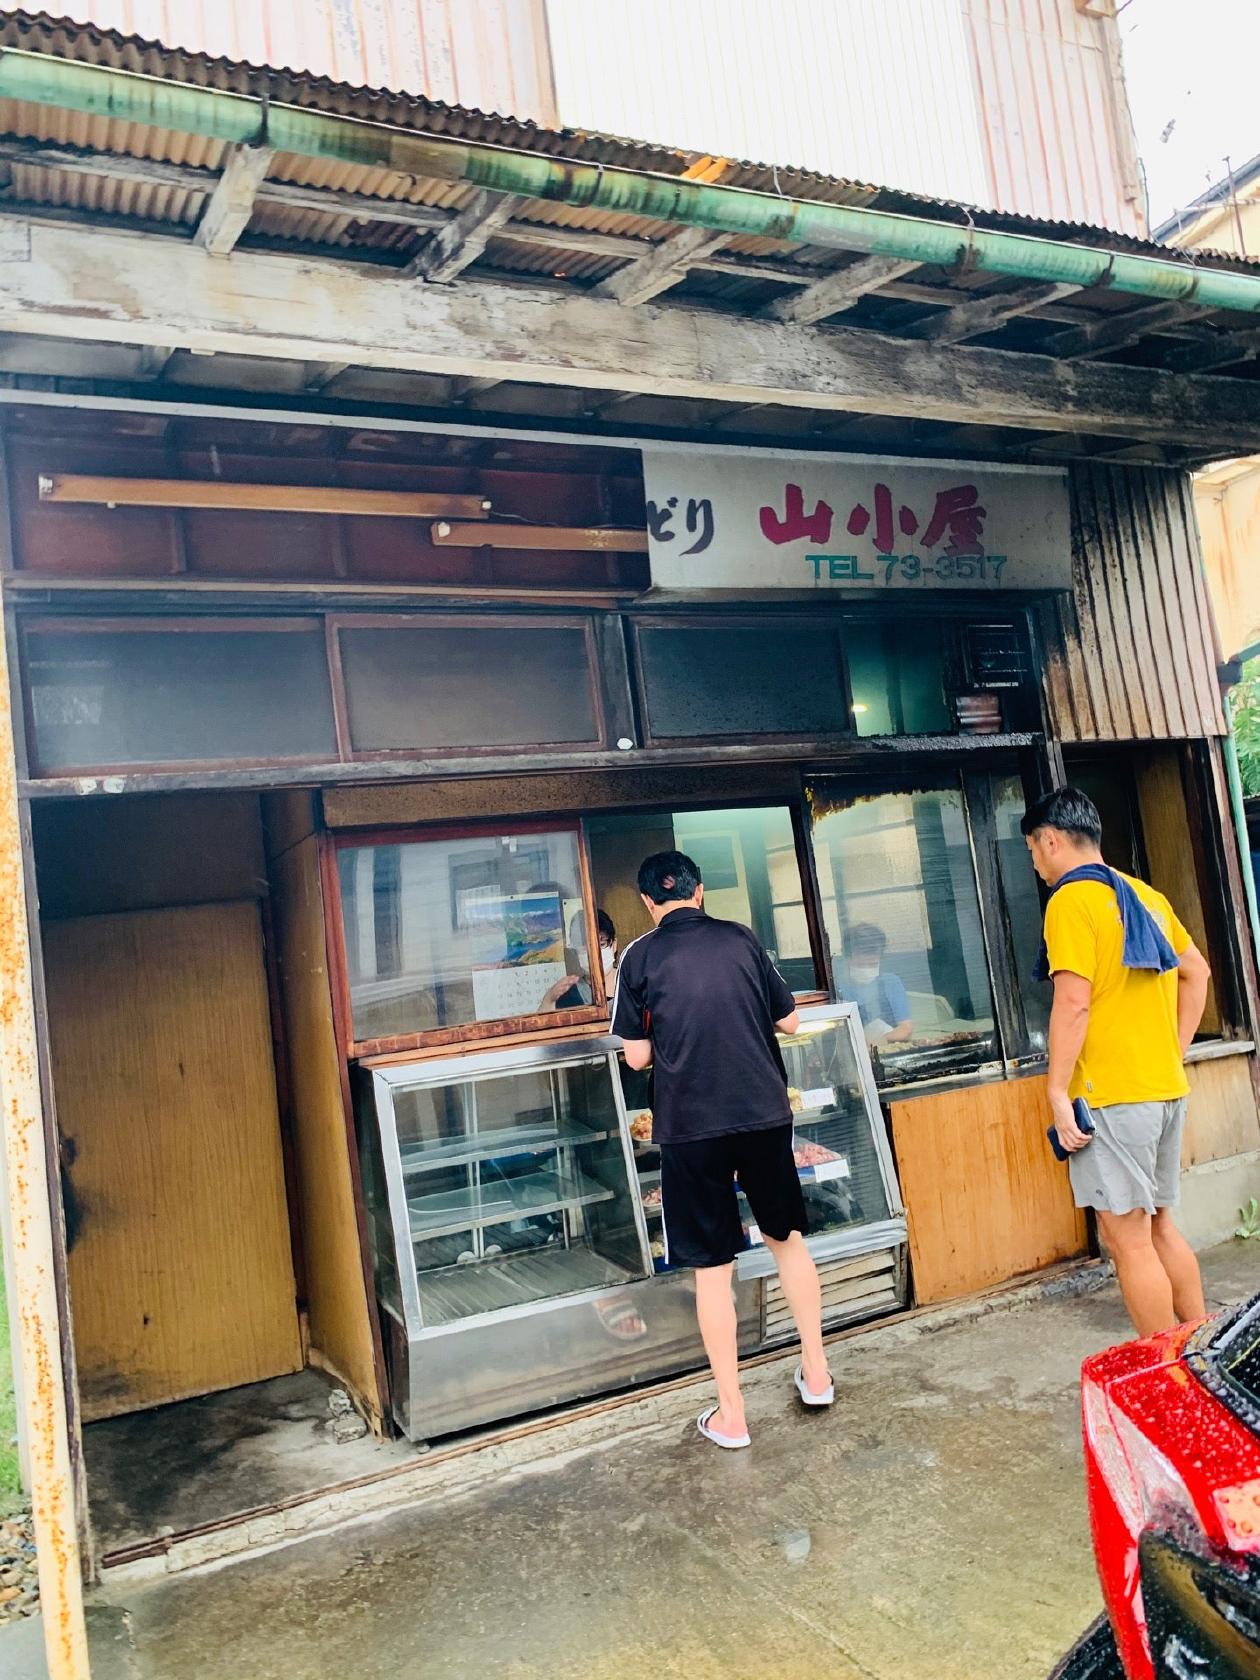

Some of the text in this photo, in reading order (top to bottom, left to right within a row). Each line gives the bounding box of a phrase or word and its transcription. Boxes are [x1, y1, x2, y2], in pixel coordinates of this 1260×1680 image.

[647, 483, 986, 556] どり 山小屋
[805, 555, 1007, 581] TEL 73-3517
